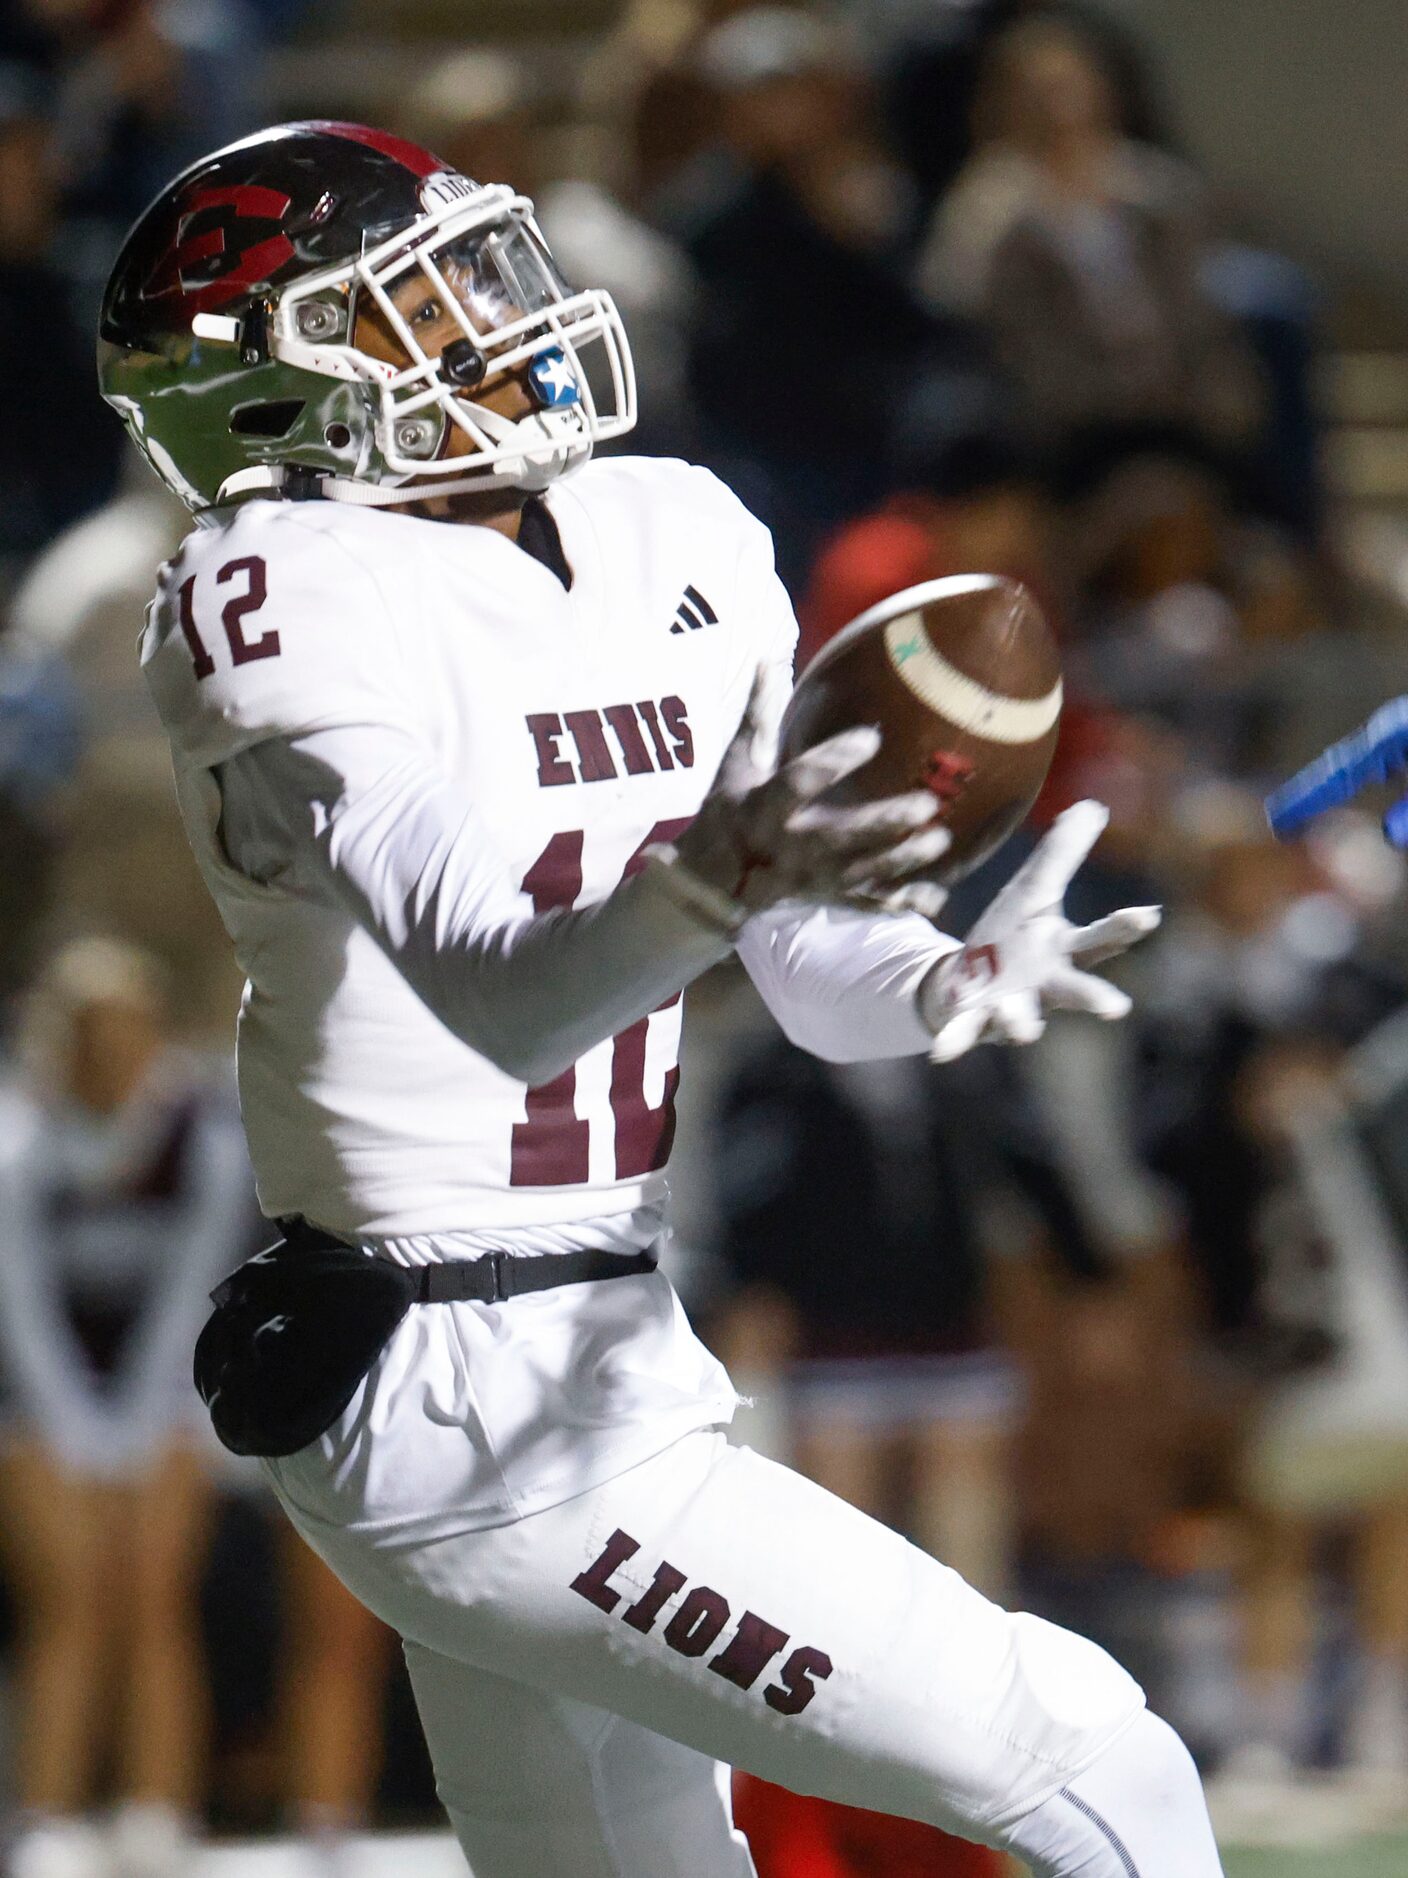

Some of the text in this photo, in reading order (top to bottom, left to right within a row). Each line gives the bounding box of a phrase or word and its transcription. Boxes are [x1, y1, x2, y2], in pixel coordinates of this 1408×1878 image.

[178, 555, 281, 681] 12
[525, 694, 695, 788] ENNIS
[569, 1527, 833, 1715] LIONS
